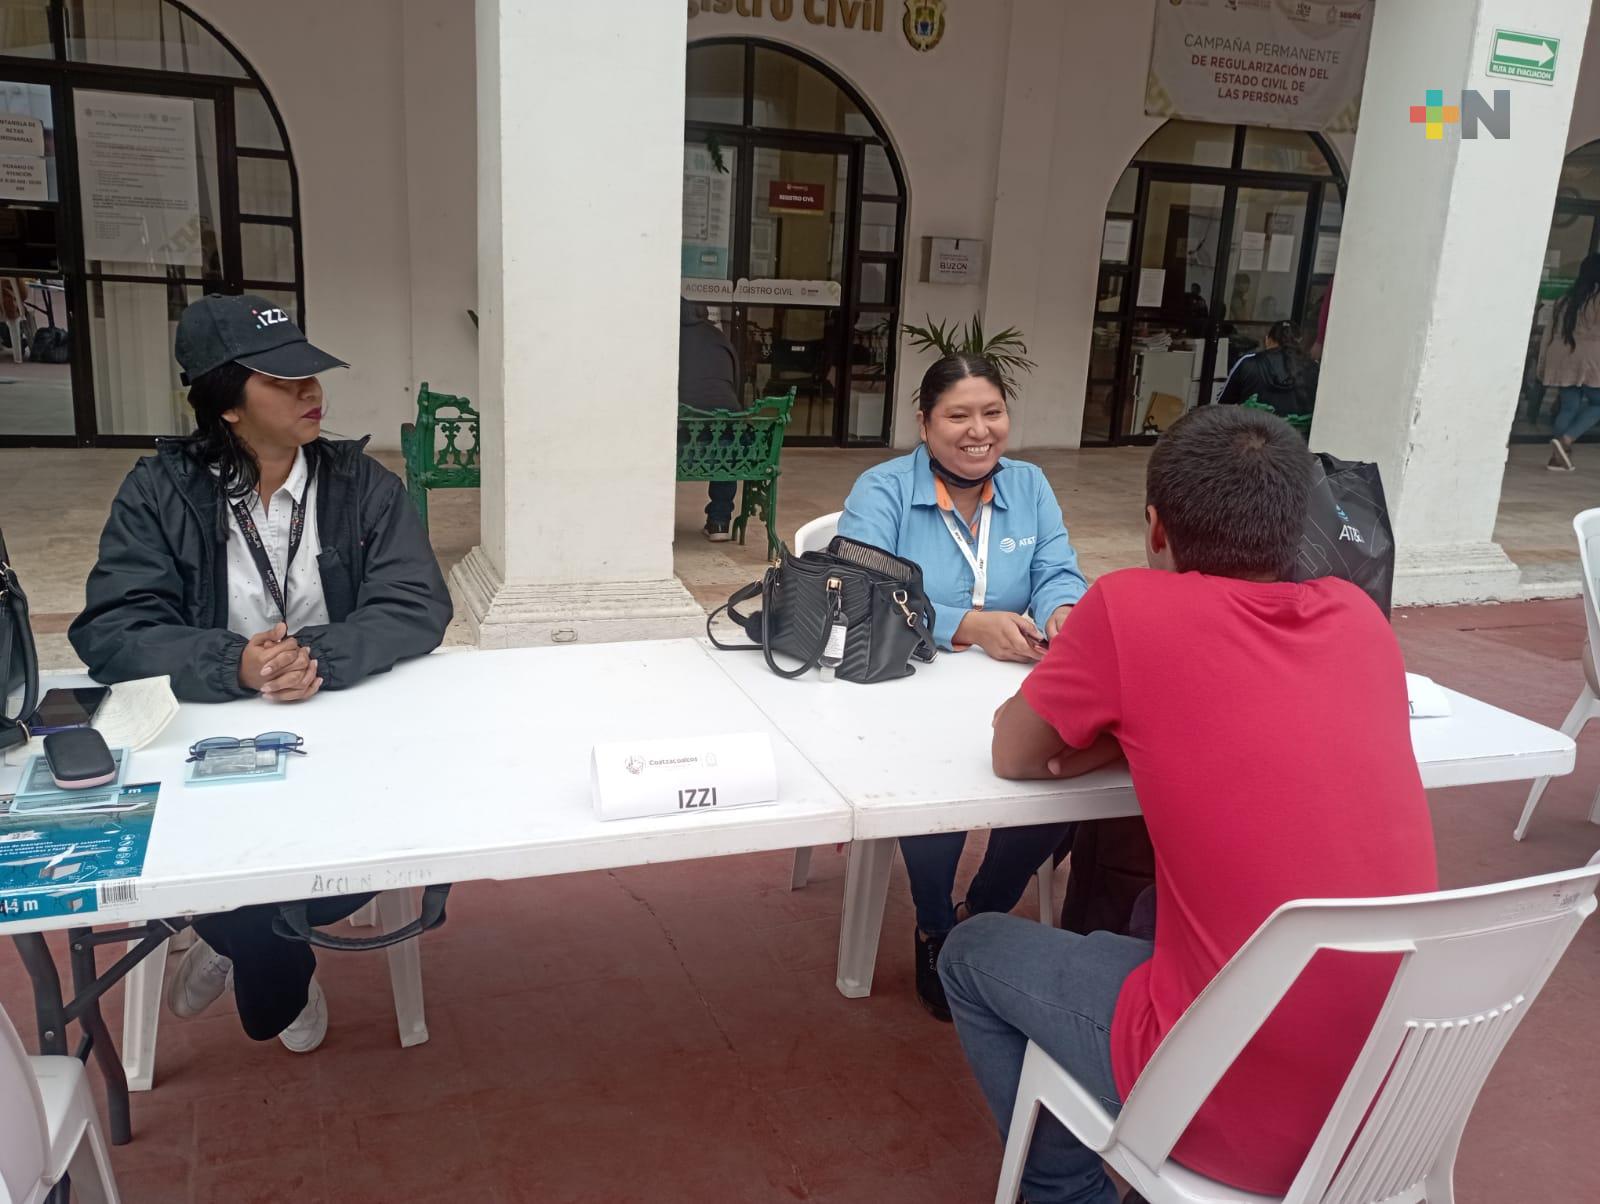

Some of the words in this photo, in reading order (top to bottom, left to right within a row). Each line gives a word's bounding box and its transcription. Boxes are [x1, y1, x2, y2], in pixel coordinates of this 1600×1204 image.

[1184, 33, 1250, 53] CAMPAÑA
[1255, 42, 1340, 64] PERMANENTE
[1191, 55, 1206, 66] DE
[1210, 57, 1307, 77] REGULARIZACIÓN
[1309, 68, 1329, 80] DEL
[1492, 64, 1507, 73] RUTA
[1214, 72, 1258, 87] ESTADO
[1261, 77, 1288, 90] CIVIL
[1291, 81, 1305, 92] DE
[1217, 87, 1239, 99] LAS
[1242, 91, 1298, 105] PERSONAS
[686, 283, 720, 293] ACCESO
[722, 284, 731, 293] AL
[774, 286, 793, 295] CIVIL
[678, 787, 717, 809] IZZI
